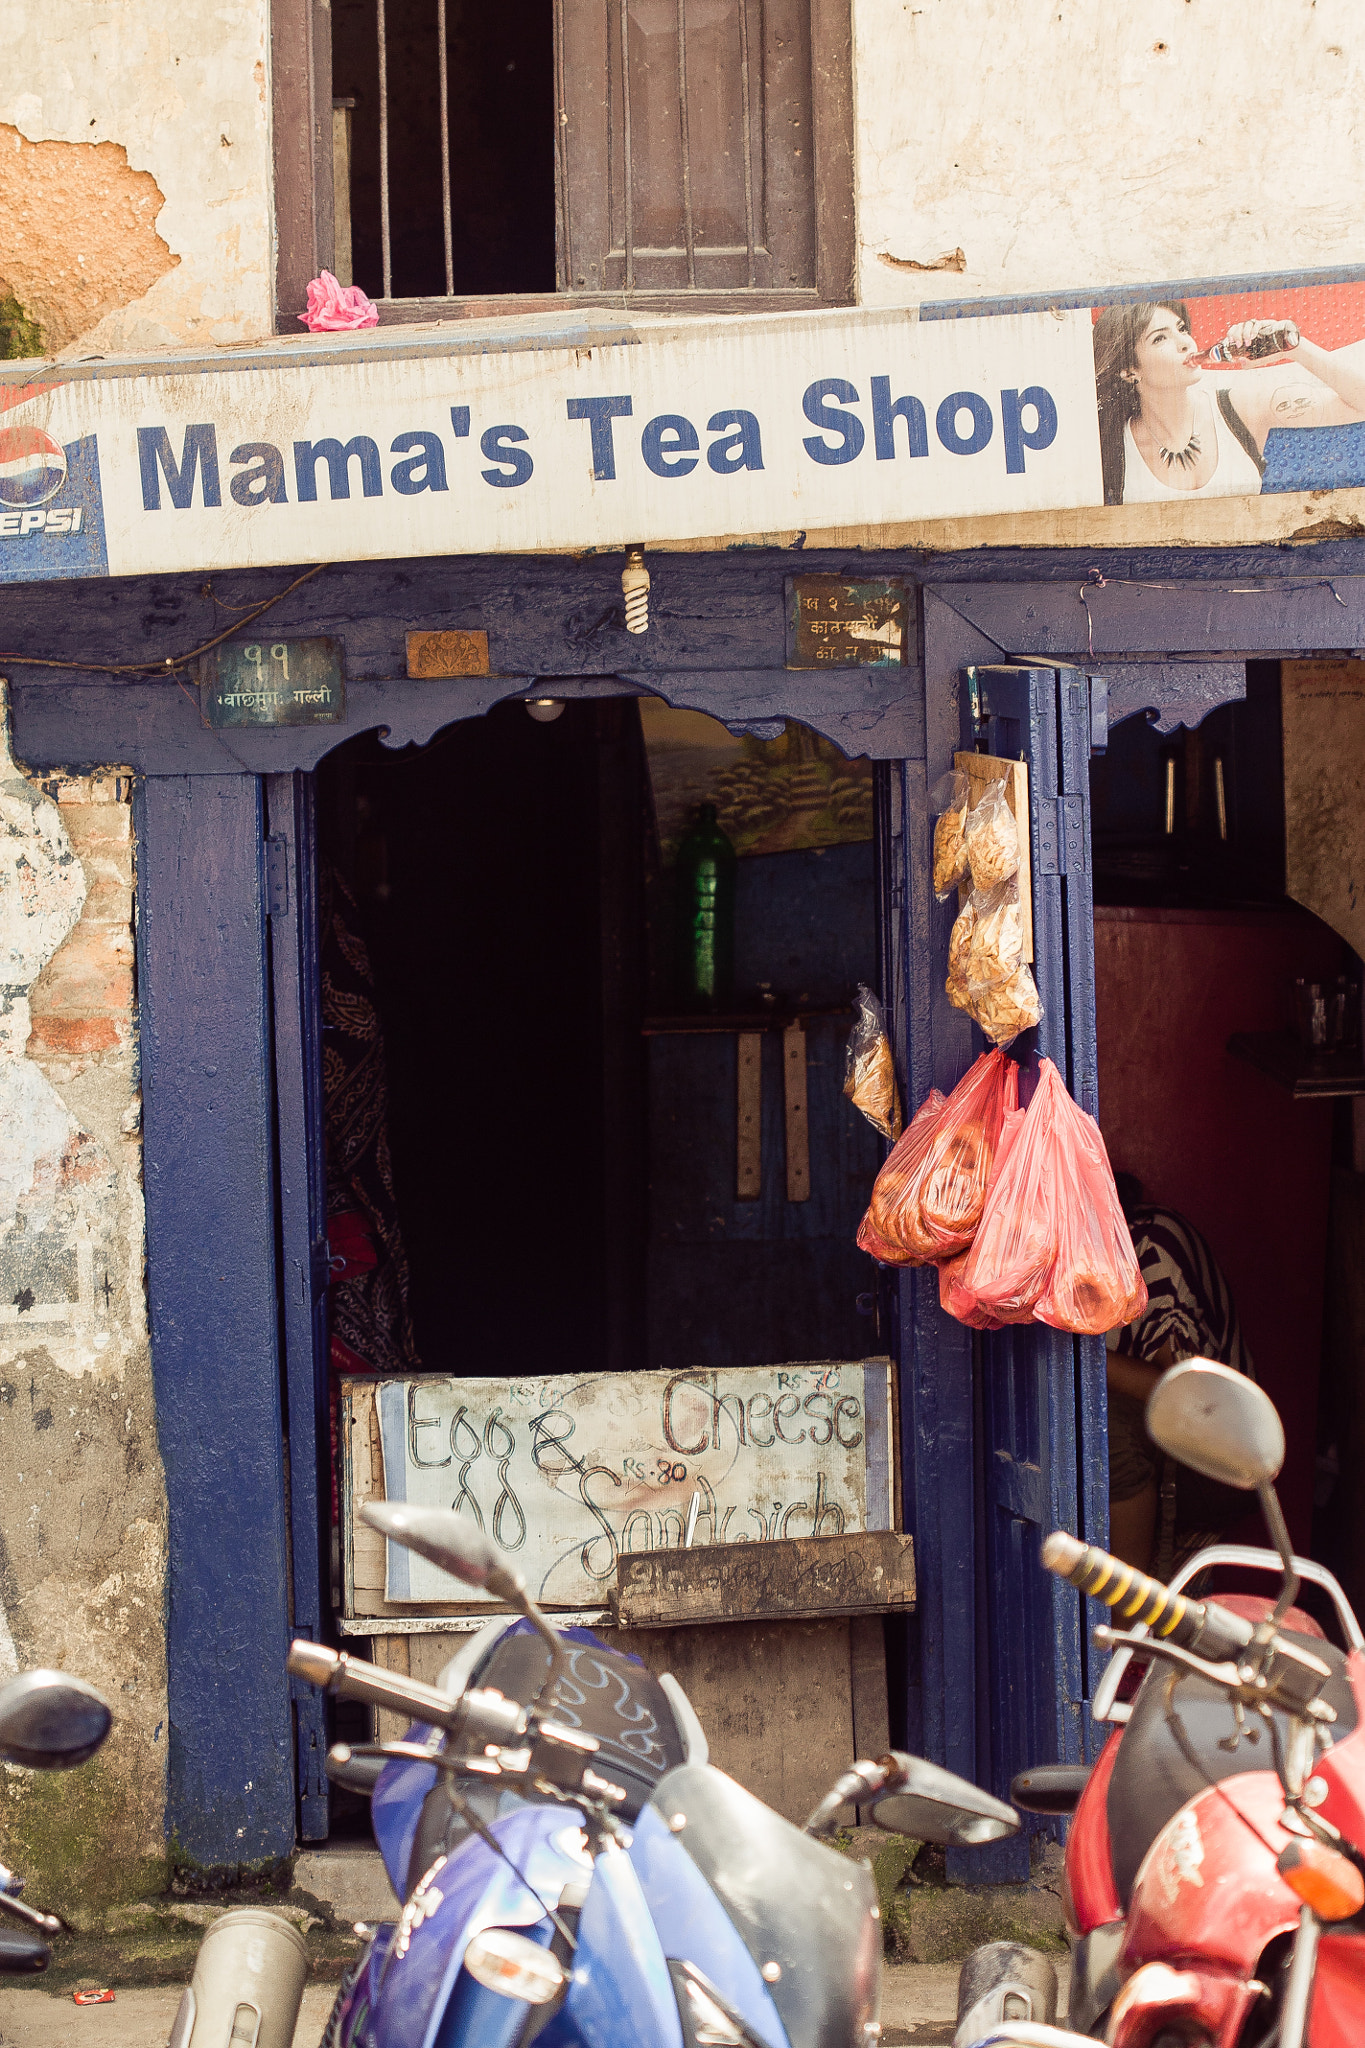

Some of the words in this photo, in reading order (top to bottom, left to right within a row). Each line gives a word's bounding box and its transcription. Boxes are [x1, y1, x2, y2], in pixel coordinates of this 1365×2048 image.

[136, 406, 534, 510] Mama's
[566, 395, 765, 480] Tea
[801, 375, 1059, 475] Shop
[0, 507, 83, 537] EPSI
[293, 684, 332, 704] गल्ली
[408, 1379, 527, 1553] Egg
[663, 1371, 863, 1455] Cheese
